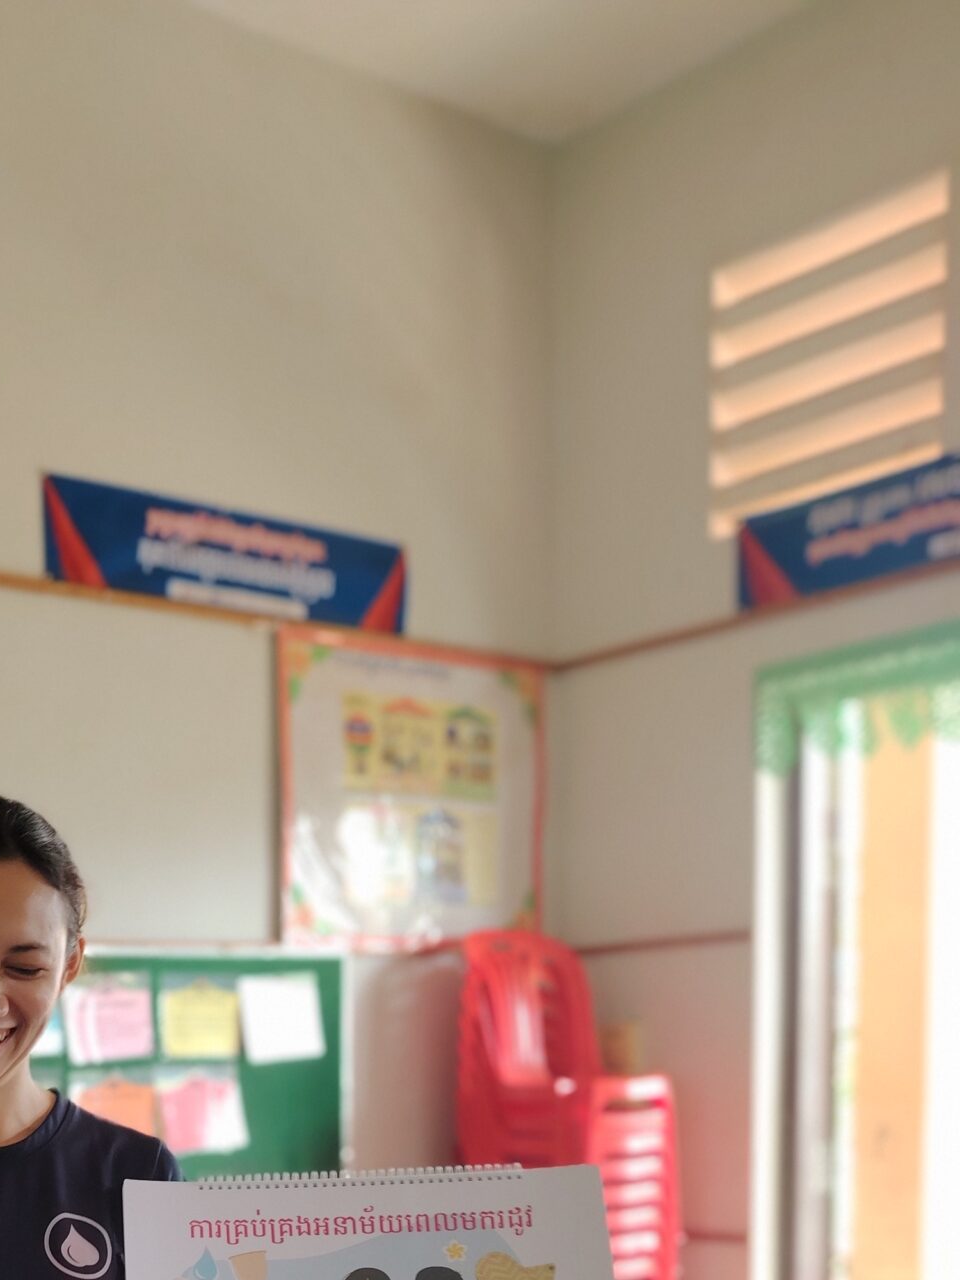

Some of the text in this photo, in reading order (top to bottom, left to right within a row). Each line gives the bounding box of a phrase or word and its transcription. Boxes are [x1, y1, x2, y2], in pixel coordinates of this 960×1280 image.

[189, 1204, 534, 1246] ការគ្រប់គ្រងអនាម័យពេលមករដូវ
